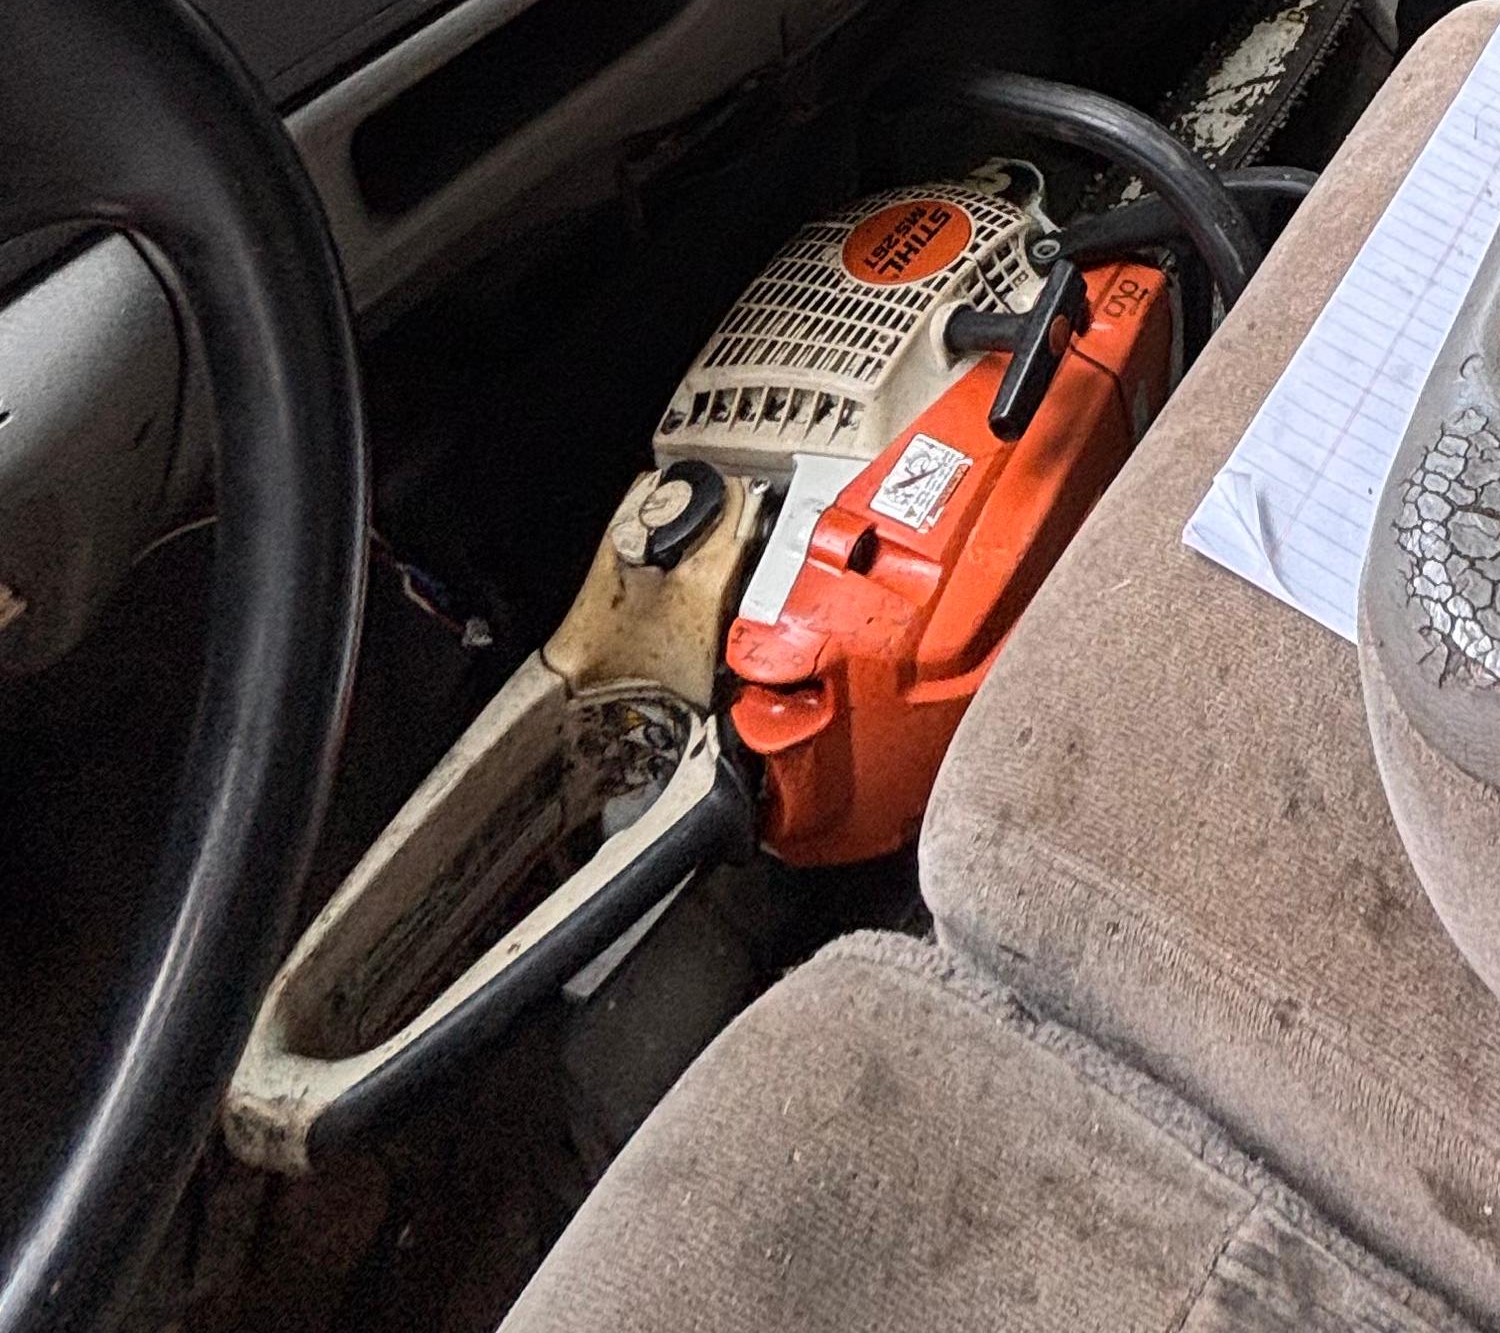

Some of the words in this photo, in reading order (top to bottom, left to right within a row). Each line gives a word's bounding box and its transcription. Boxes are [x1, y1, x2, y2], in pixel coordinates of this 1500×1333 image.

[894, 206, 928, 237] MS
[863, 233, 901, 269] 261
[877, 206, 952, 275] STIHL
